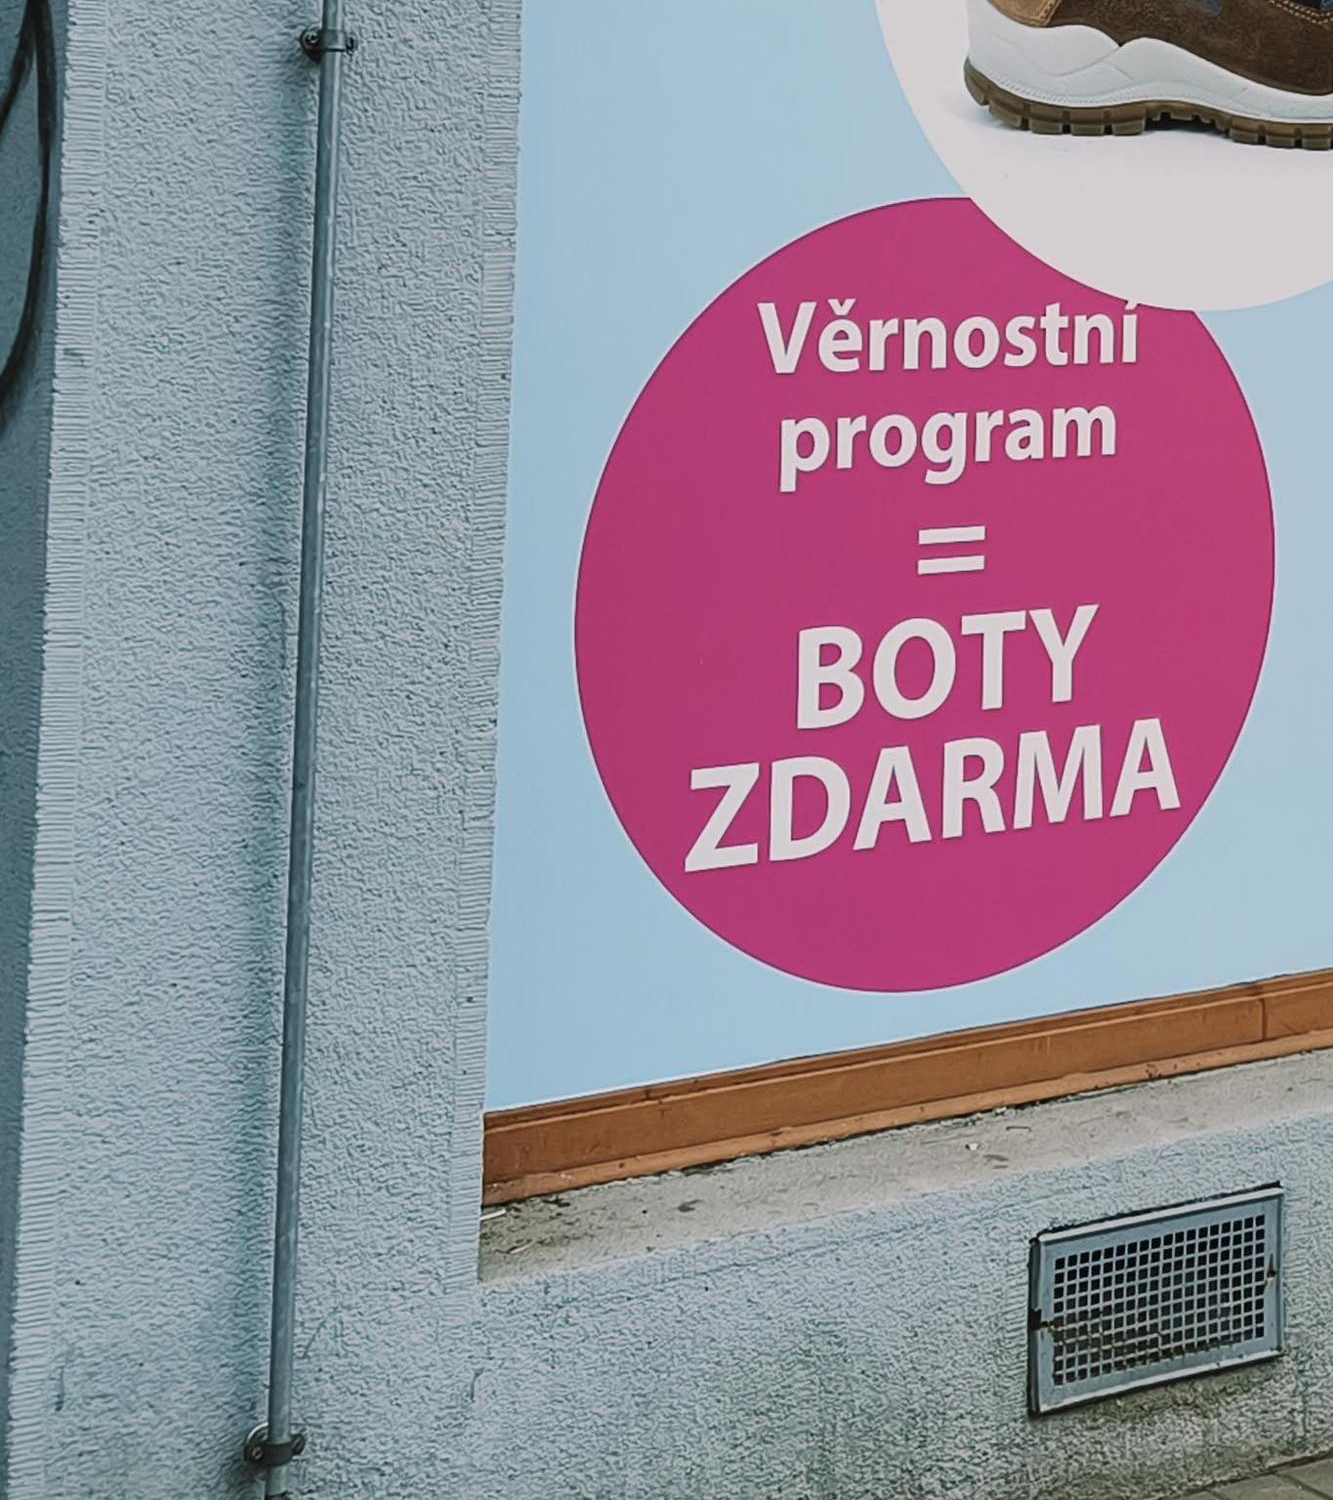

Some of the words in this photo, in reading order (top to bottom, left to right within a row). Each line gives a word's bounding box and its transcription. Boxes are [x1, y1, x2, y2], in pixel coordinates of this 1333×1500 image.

[756, 298, 1139, 375] Věrnostní
[779, 404, 1117, 494] program
[796, 604, 1100, 730] BOTY
[684, 717, 1181, 873] ZDARMA
